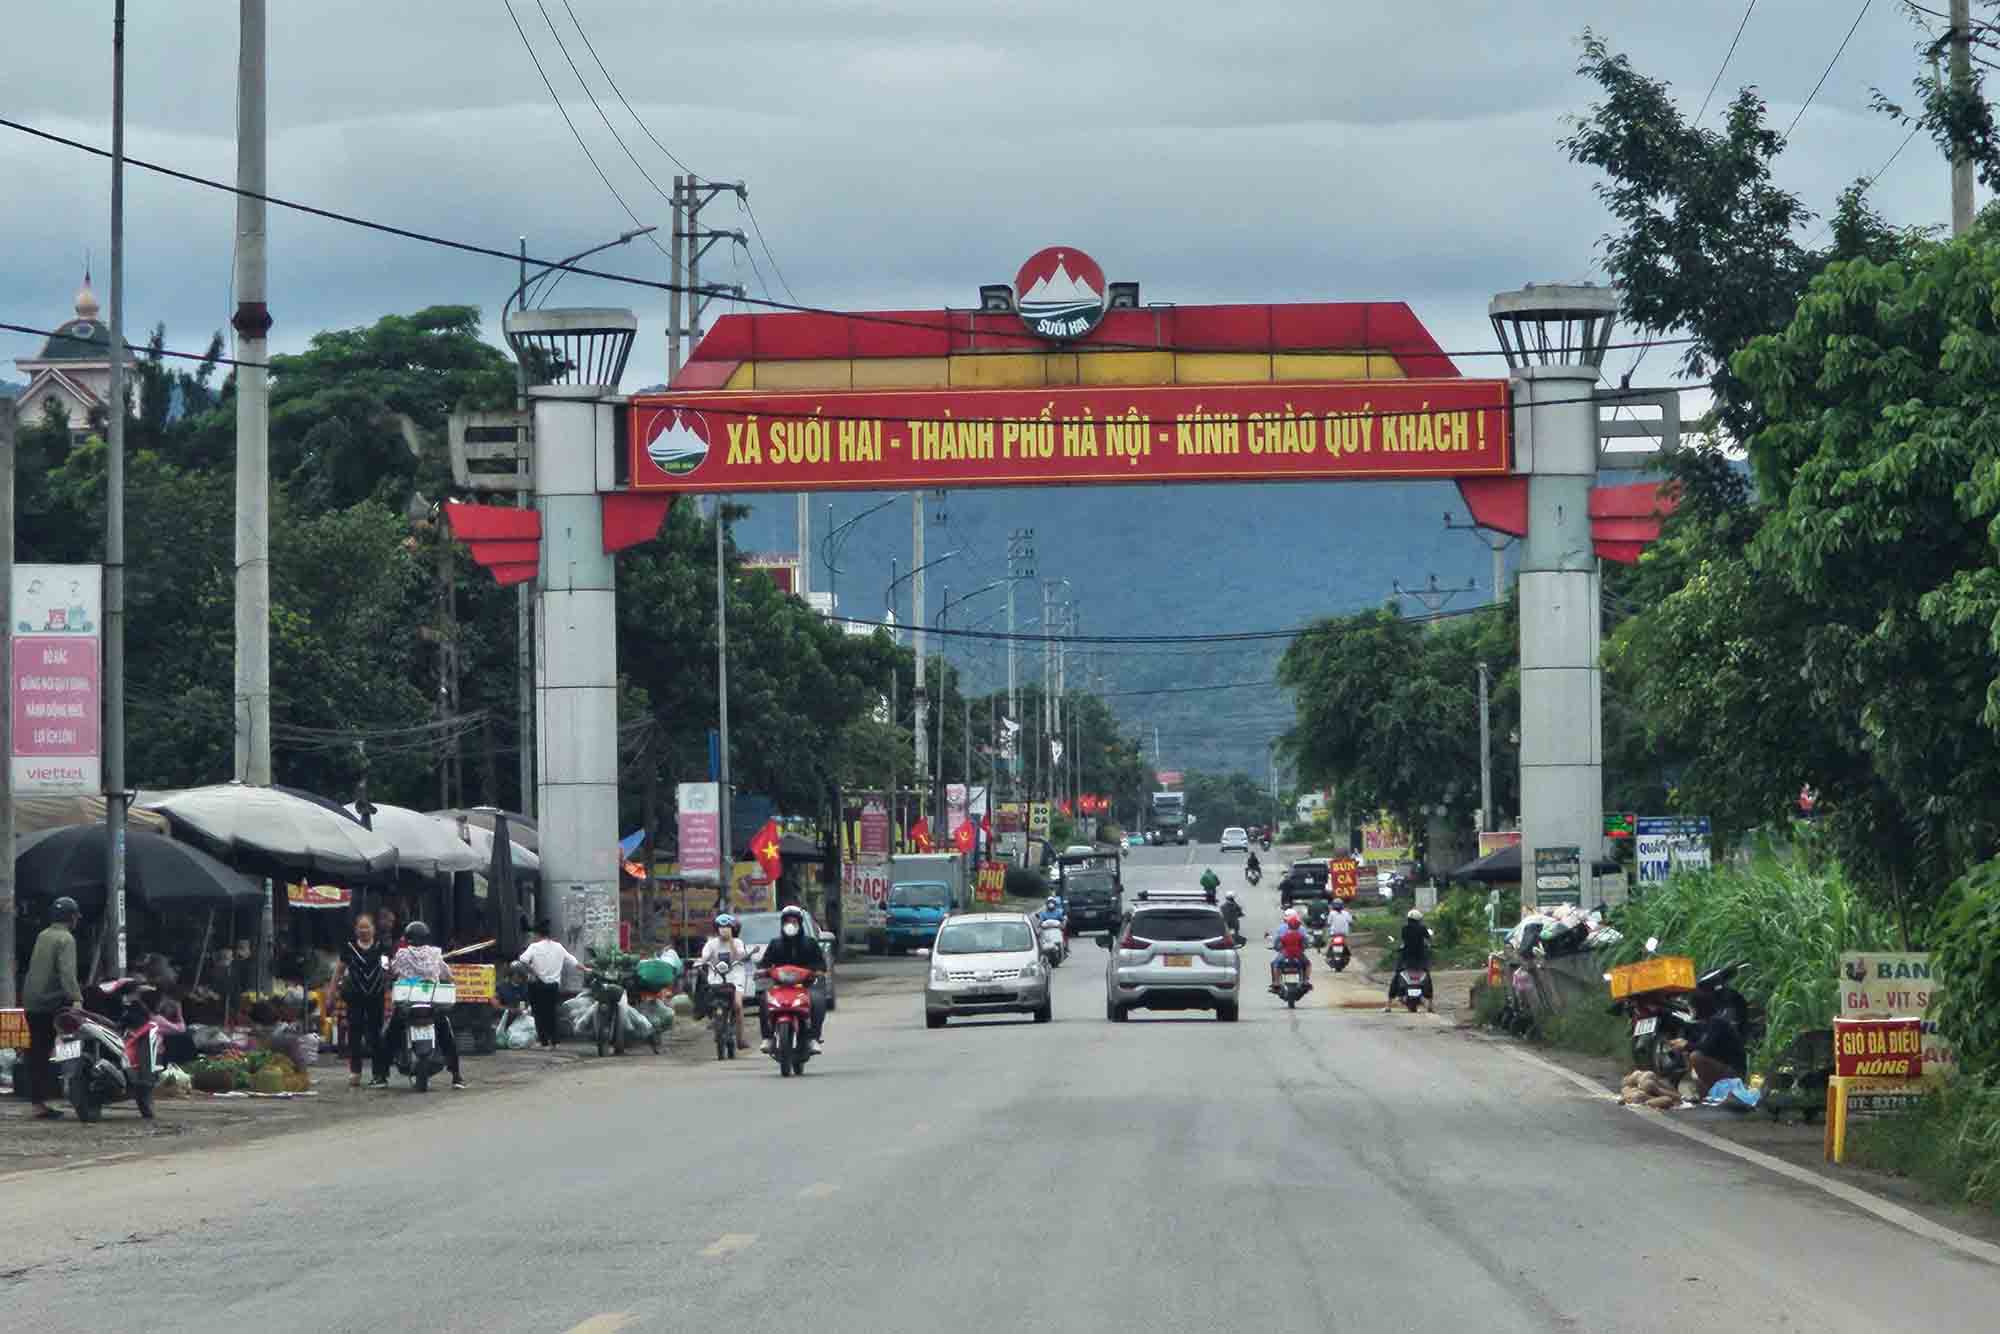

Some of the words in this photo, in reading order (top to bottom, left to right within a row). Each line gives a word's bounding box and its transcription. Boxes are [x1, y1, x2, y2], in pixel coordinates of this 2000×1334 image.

[1037, 318, 1067, 336] SUỐI
[1068, 316, 1090, 335] HAI
[727, 416, 762, 464] XÃ
[769, 406, 831, 464] SUỐI
[839, 420, 881, 462] HAI
[908, 409, 994, 460] THÀNH
[1002, 401, 1054, 458] PHỐ
[1063, 407, 1098, 457] HÀ
[1105, 405, 1151, 465] NỘI
[1176, 405, 1240, 455] KÍNH
[1247, 402, 1316, 454] CHÀO
[1324, 402, 1372, 457] QUÝ
[1382, 401, 1469, 453] KHÁCH
[26, 766, 82, 780] viettel
[1640, 862, 1670, 881] KIM
